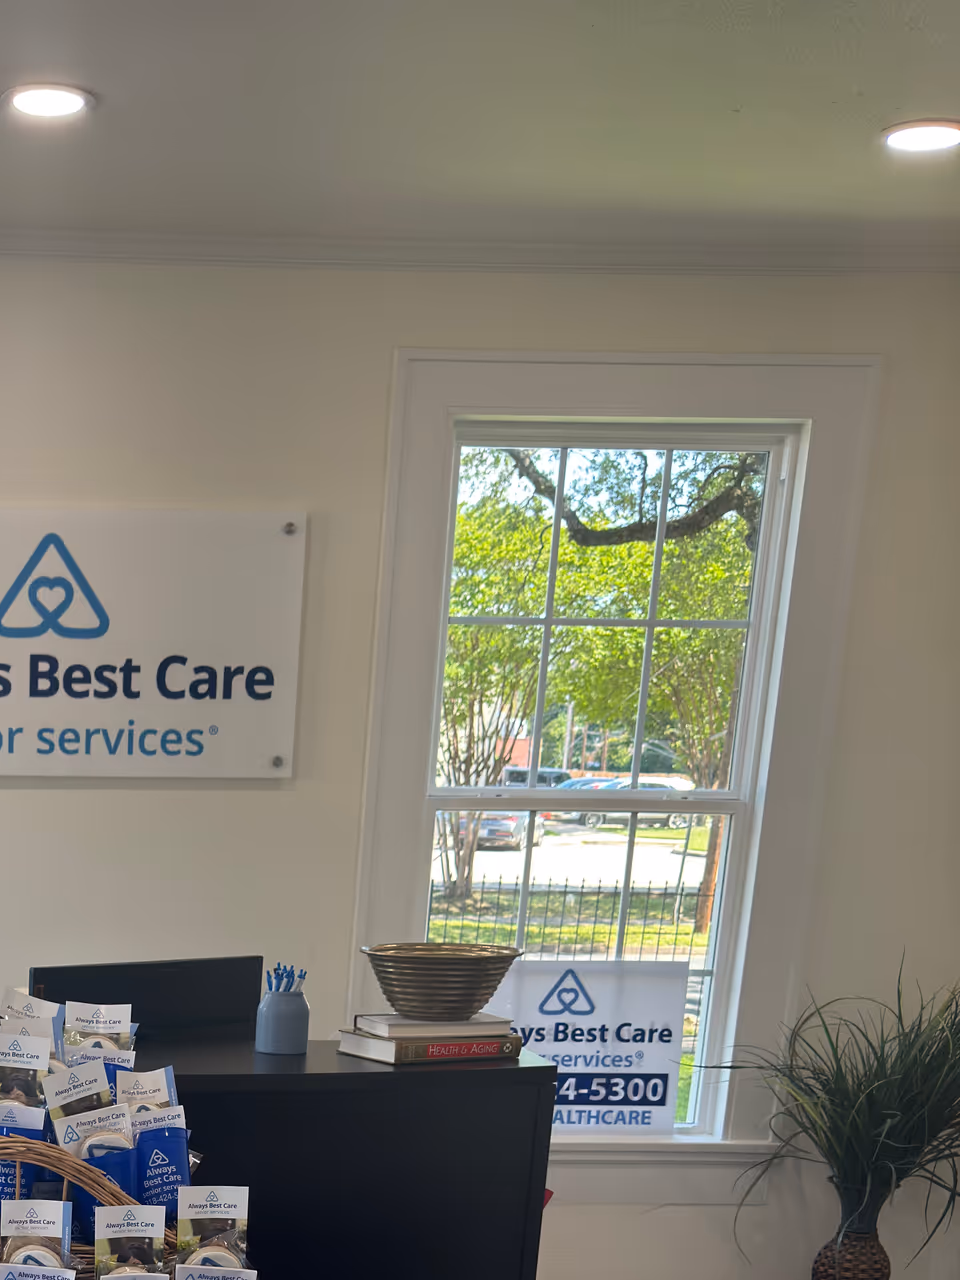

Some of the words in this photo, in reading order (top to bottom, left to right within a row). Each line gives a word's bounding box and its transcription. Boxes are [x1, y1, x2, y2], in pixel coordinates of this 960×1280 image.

[28, 654, 141, 700] Best
[155, 655, 274, 700] Care
[75, 1017, 94, 1025] Always
[554, 1023, 608, 1043] Best
[615, 1023, 672, 1043] Care
[470, 1044, 497, 1053] AGING
[55, 1086, 73, 1097] Always
[73, 1082, 84, 1090] Best
[76, 1119, 97, 1129] Always
[97, 1115, 110, 1123] Best
[152, 1115, 166, 1123] Best
[552, 1110, 651, 1125] ALTHCARE
[147, 1166, 176, 1177] Always
[144, 1177, 162, 1188] Best
[18, 1272, 41, 1280] Always
